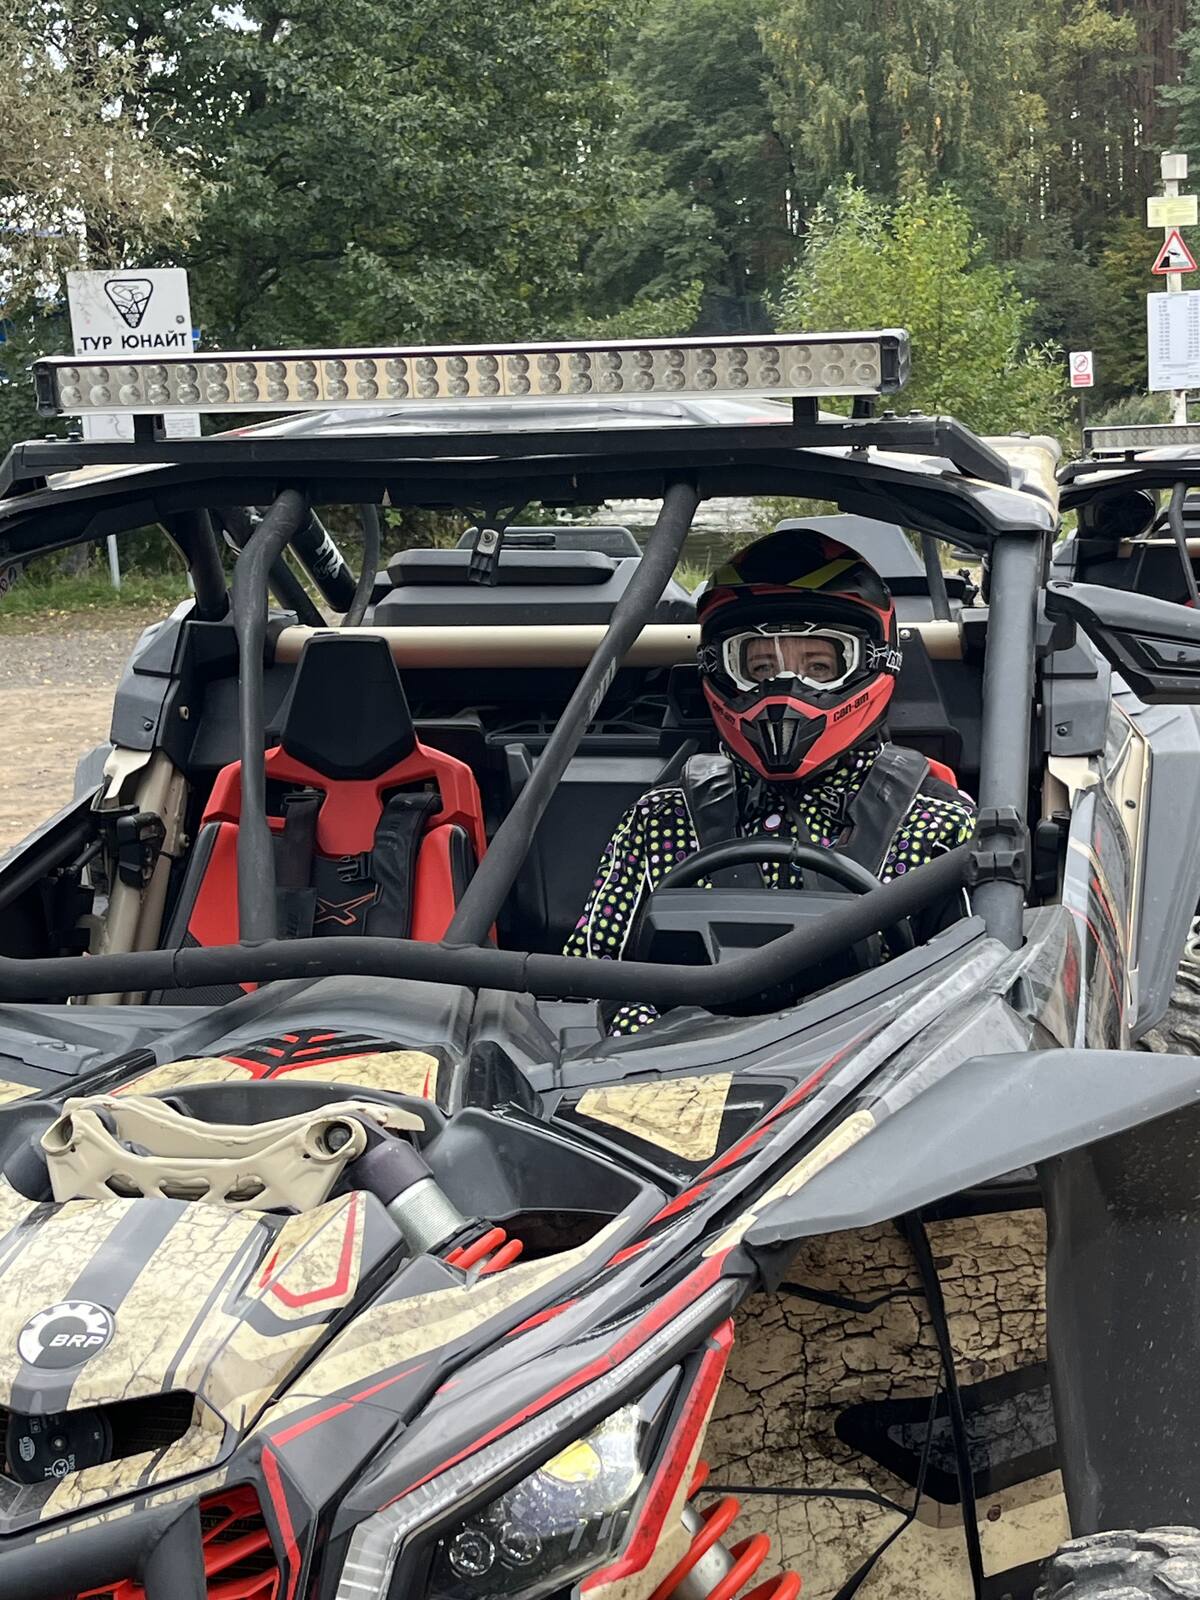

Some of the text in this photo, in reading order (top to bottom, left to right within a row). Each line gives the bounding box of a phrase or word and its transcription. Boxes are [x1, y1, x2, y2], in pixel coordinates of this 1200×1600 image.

[80, 330, 187, 351] ТУР ЮНАЙТ
[49, 1333, 104, 1349] BRP
